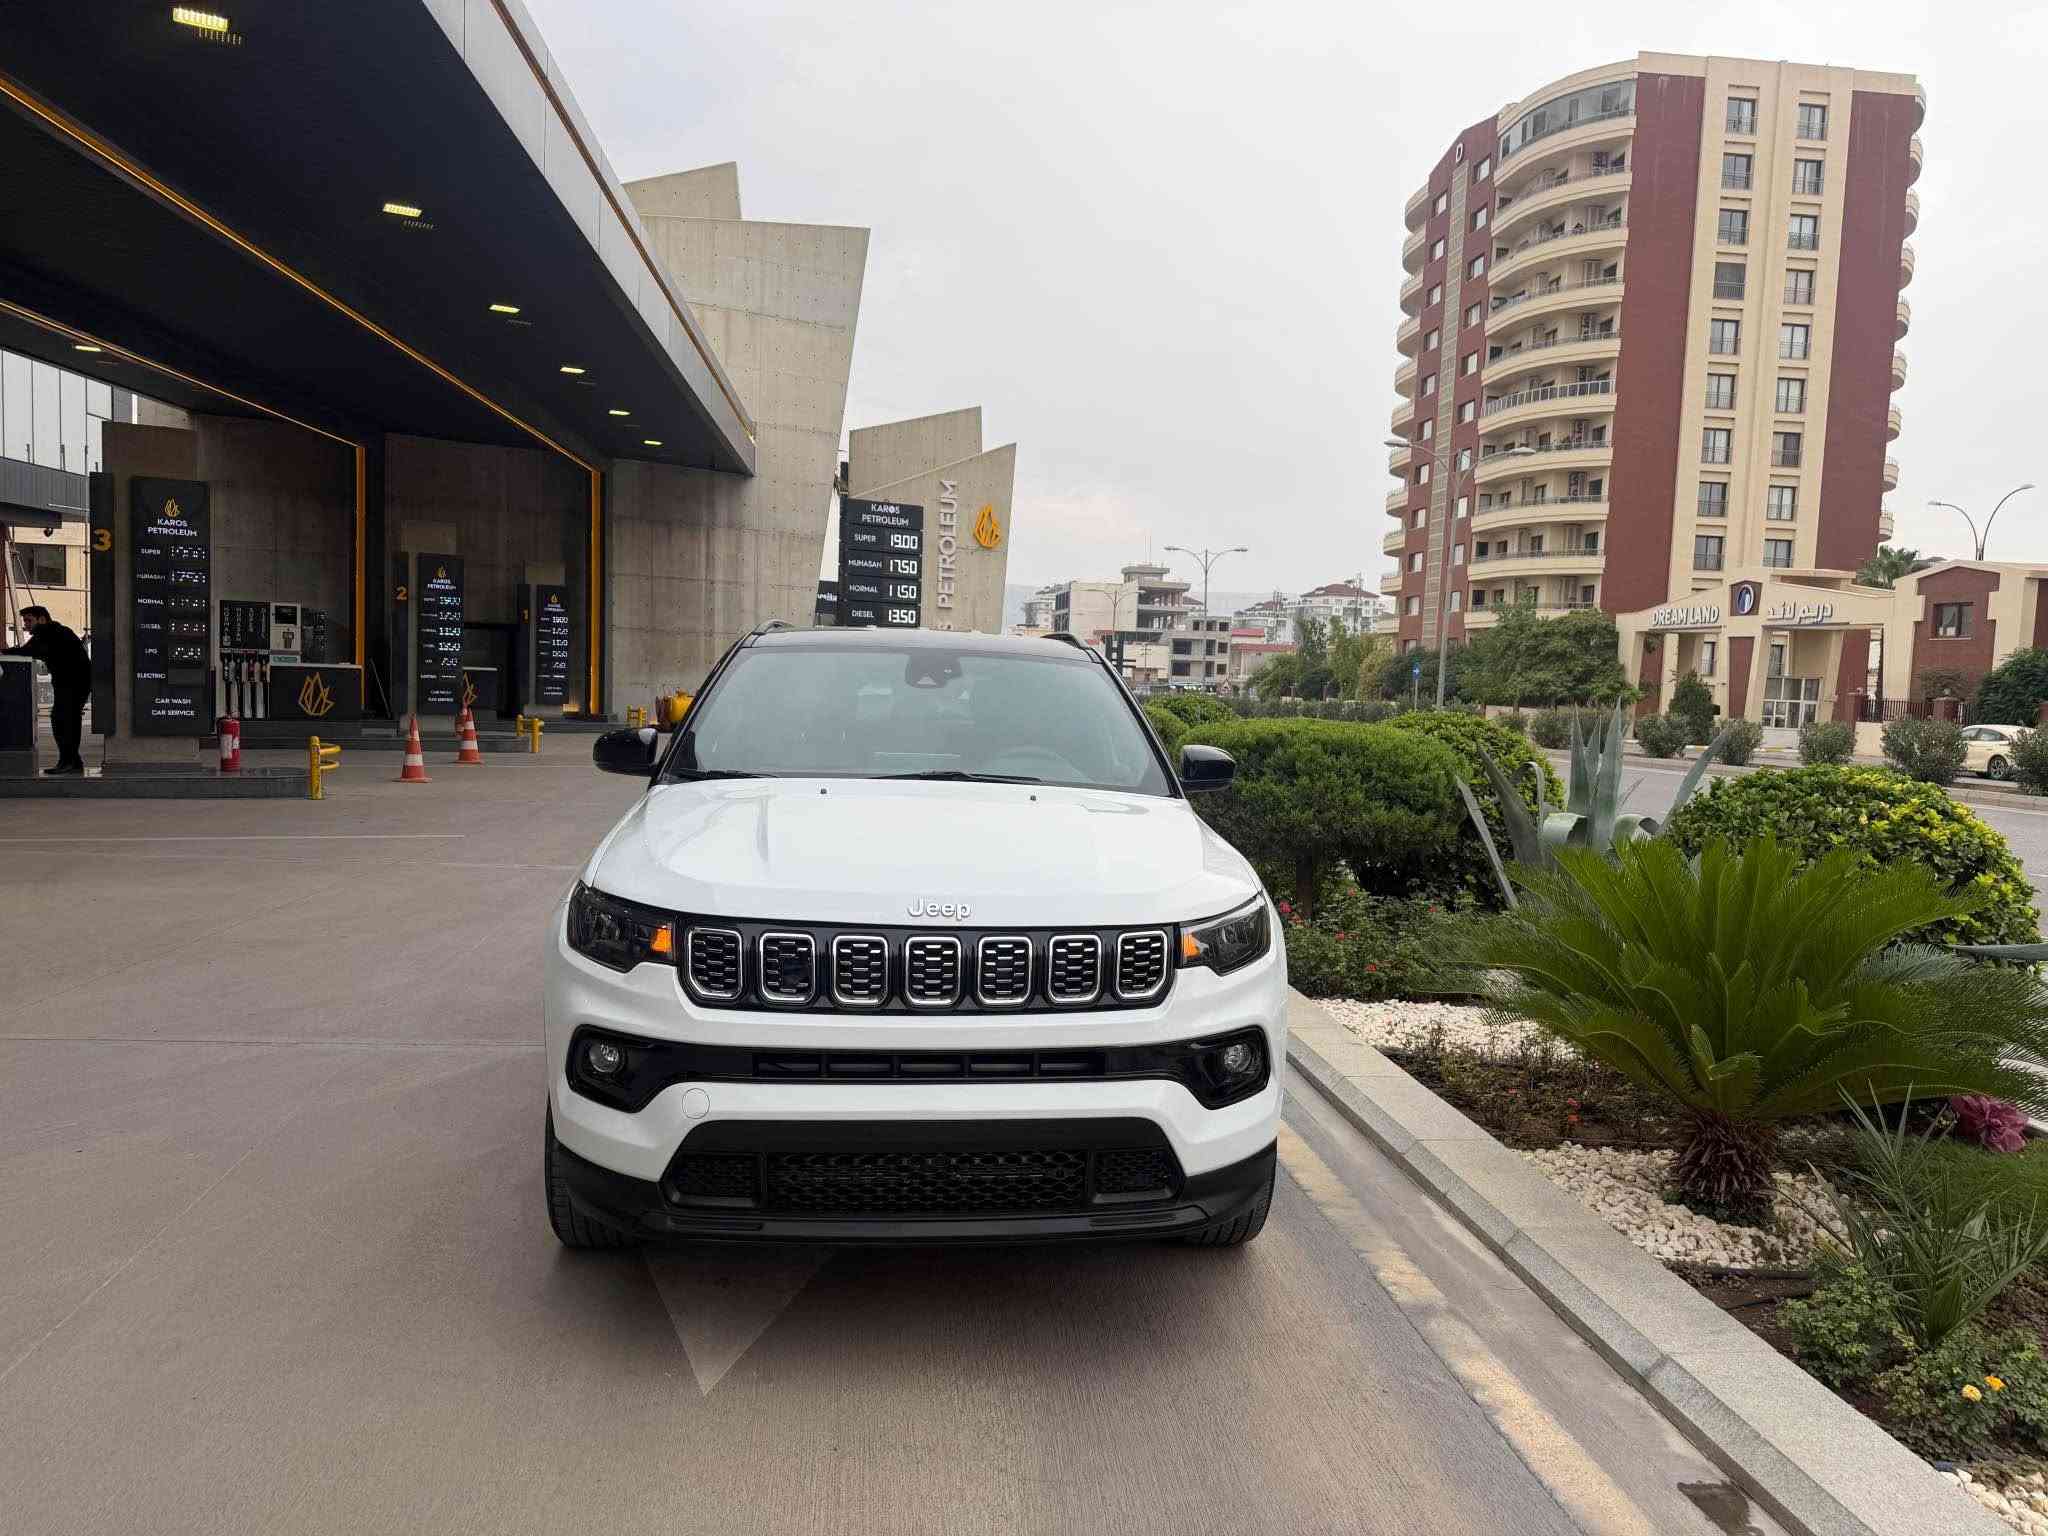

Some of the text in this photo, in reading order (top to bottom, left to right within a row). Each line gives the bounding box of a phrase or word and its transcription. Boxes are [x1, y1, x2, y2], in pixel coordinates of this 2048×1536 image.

[871, 504, 900, 514] KAROS
[157, 518, 188, 527] KAROS
[862, 514, 909, 527] PETROLEUM
[147, 527, 198, 537] PETROLEUM
[94, 528, 113, 552] 3
[854, 533, 876, 543] SUPER
[937, 480, 958, 609] PETROLEUM
[396, 586, 408, 600] 2
[849, 584, 878, 593] NORMAL
[851, 609, 874, 618] DIESEL
[1652, 605, 1720, 627] DREAM LAND
[908, 895, 971, 921] Jeep
